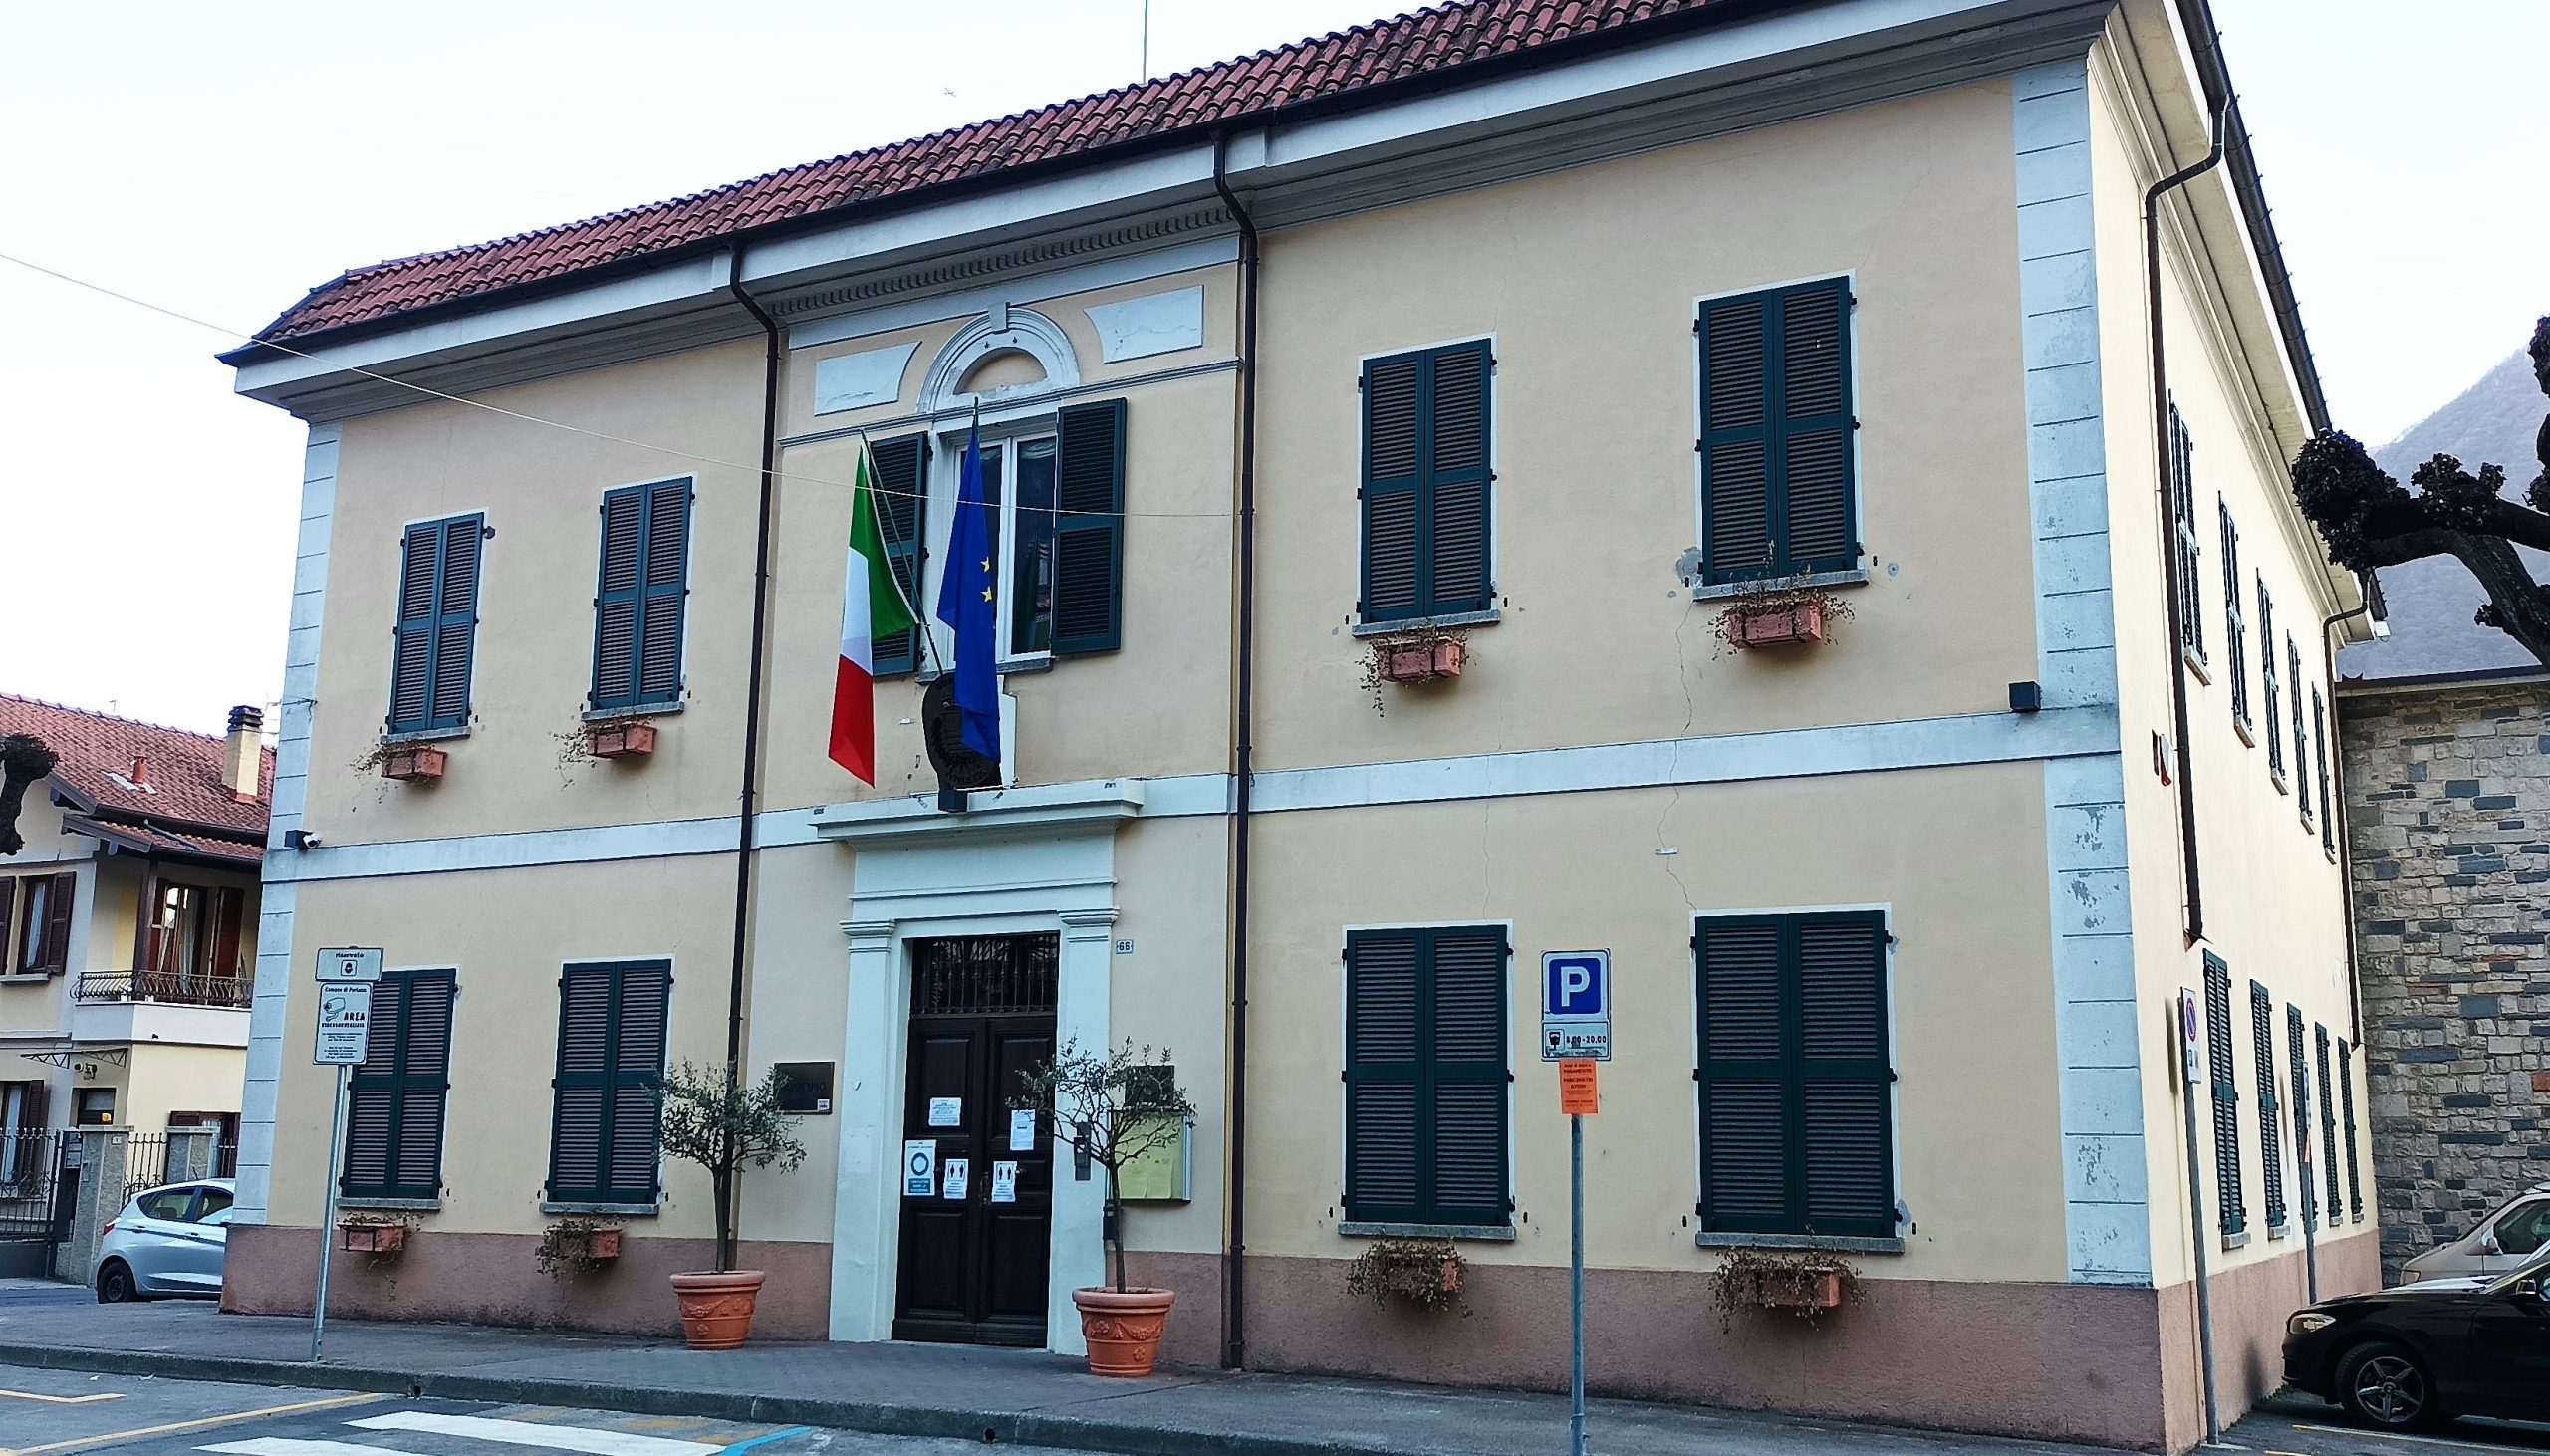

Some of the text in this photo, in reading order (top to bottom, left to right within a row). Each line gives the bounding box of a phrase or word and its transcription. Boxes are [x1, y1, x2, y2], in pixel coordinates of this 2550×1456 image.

[1119, 941, 1131, 951] 66
[1560, 966, 1591, 1007] P
[343, 1012, 365, 1021] AREA
